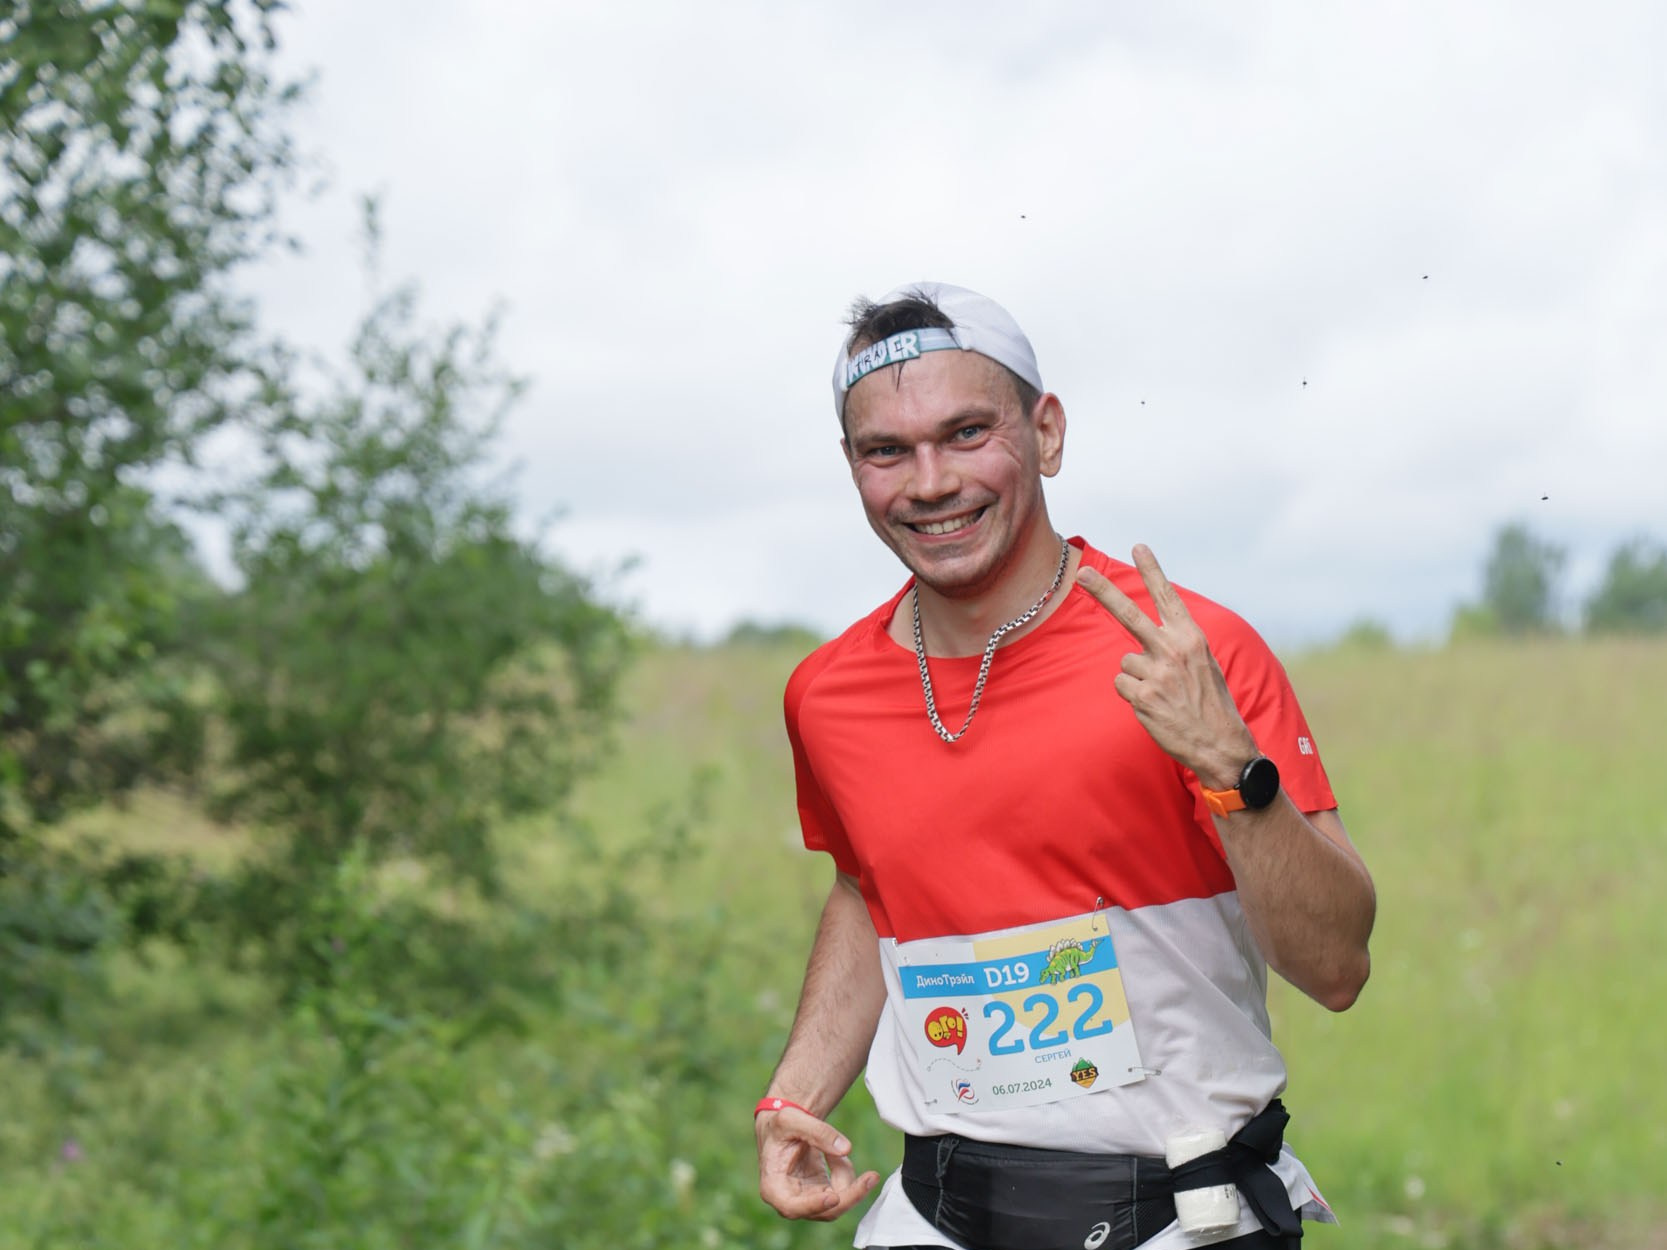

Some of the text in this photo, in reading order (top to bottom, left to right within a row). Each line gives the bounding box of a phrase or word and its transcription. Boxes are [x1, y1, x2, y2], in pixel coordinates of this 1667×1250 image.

[916, 962, 1030, 988] ДиноТрэйл D19
[983, 983, 1113, 1056] 222
[1034, 1049, 1072, 1064] СЕРГЕЙ
[1072, 1067, 1097, 1081] YES
[992, 1078, 1052, 1096] 06.07.2024
